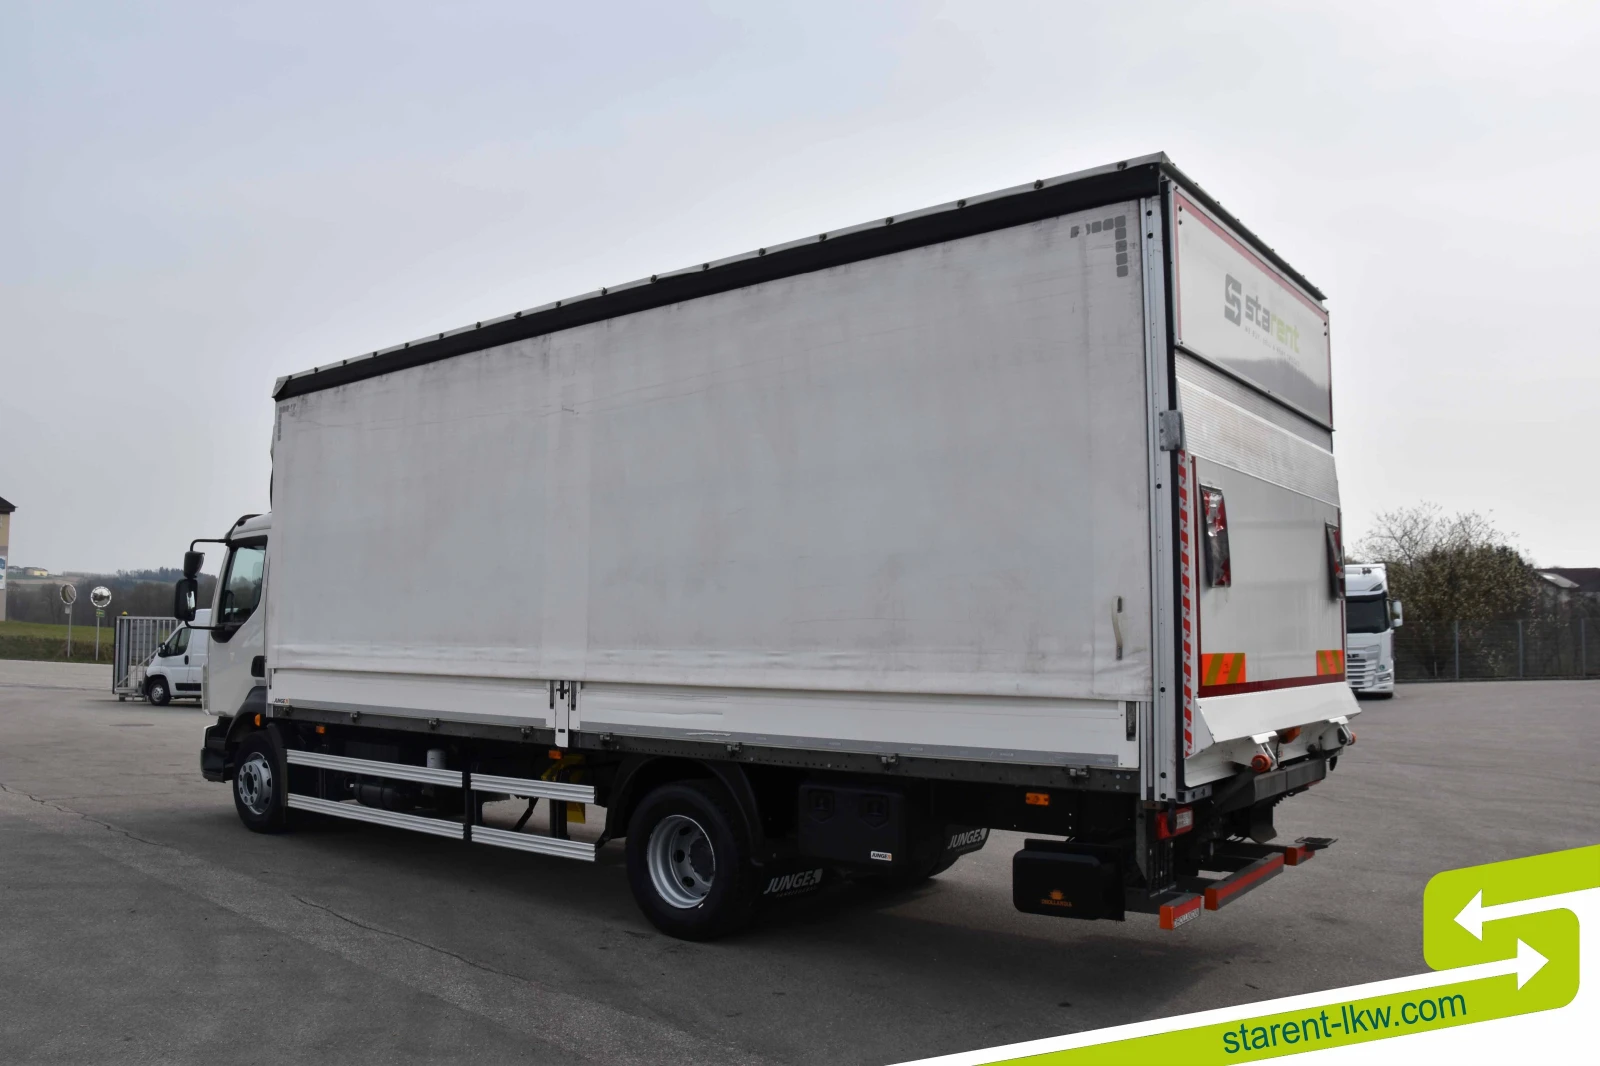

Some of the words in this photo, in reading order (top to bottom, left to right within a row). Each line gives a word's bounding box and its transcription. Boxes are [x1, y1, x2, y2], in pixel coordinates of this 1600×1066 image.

[1245, 294, 1300, 354] starent
[947, 829, 981, 850] JUNGE
[872, 852, 888, 860] JUNGE
[763, 870, 813, 895] JUNGE
